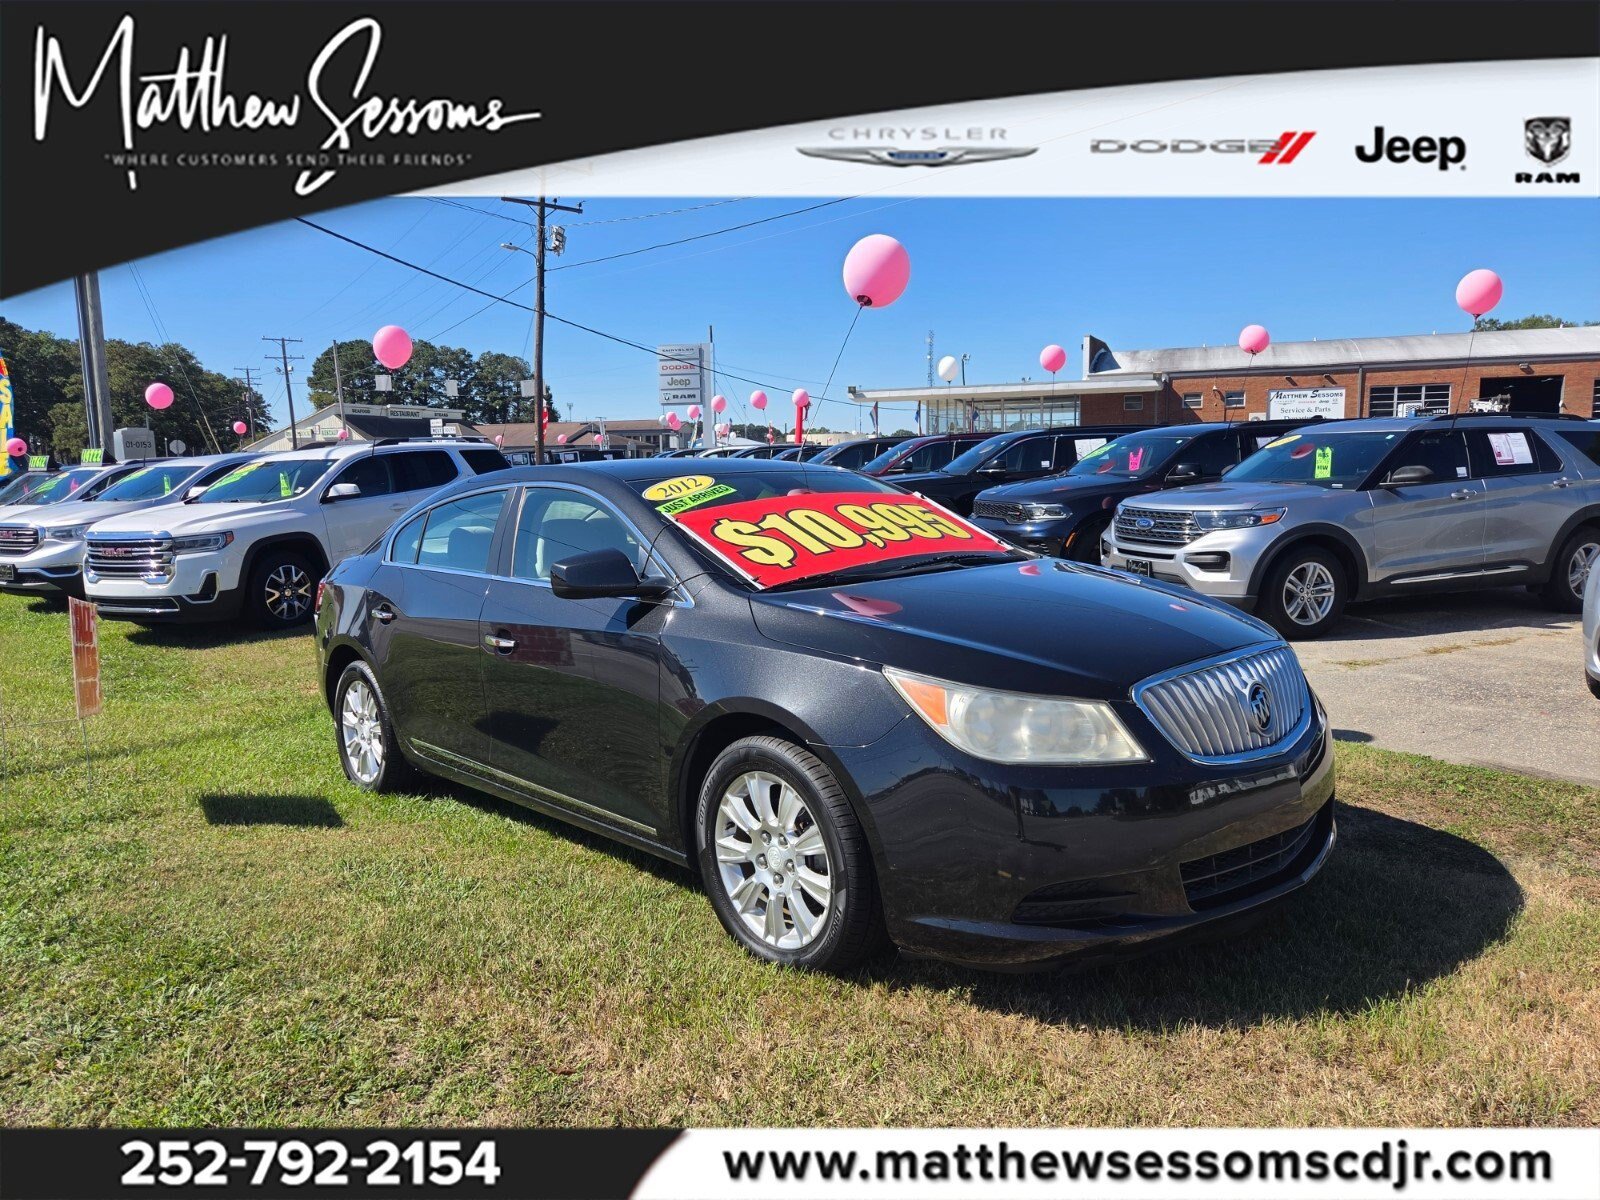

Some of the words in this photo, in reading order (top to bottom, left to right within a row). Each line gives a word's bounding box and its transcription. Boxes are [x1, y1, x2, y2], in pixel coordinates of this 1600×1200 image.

[667, 377, 691, 387] Jeep
[390, 410, 420, 418] RESTAURANT
[125, 441, 152, 449] 01-0153
[656, 477, 703, 498] 2012
[662, 498, 689, 513] JUST
[688, 486, 730, 503] ARRIVED
[711, 503, 972, 569] $10,995
